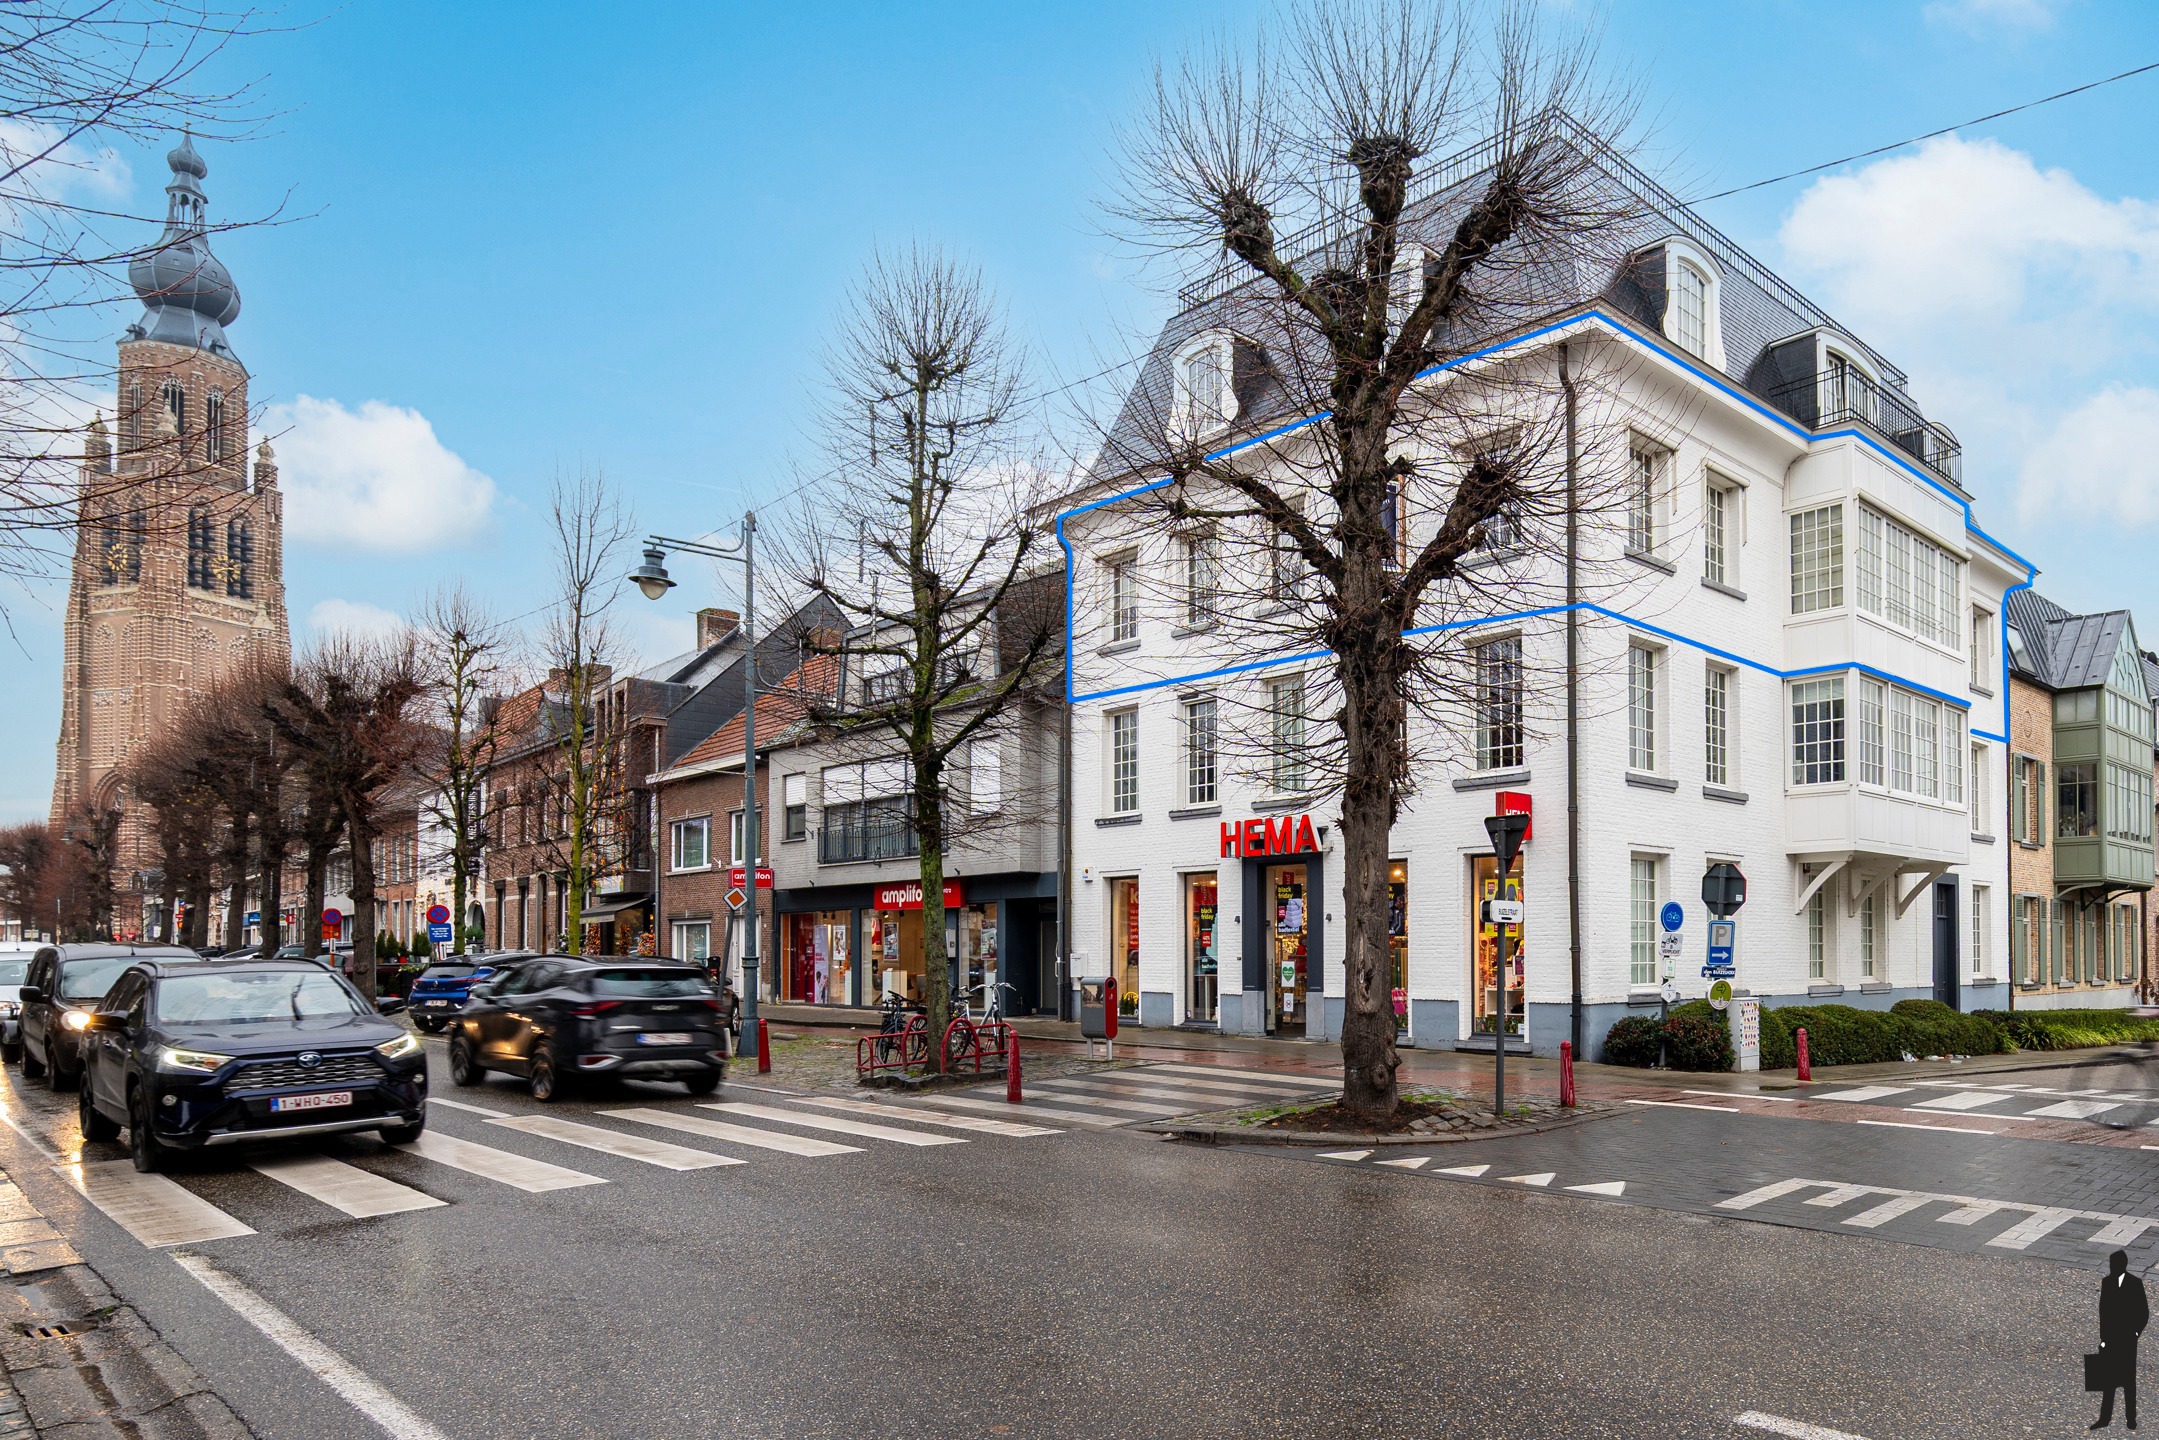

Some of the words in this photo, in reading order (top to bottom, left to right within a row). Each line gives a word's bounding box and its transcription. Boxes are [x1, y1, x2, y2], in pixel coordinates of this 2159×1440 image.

[1220, 814, 1320, 858] HEMA
[734, 872, 770, 880] amifon
[881, 884, 923, 907] amplifo
